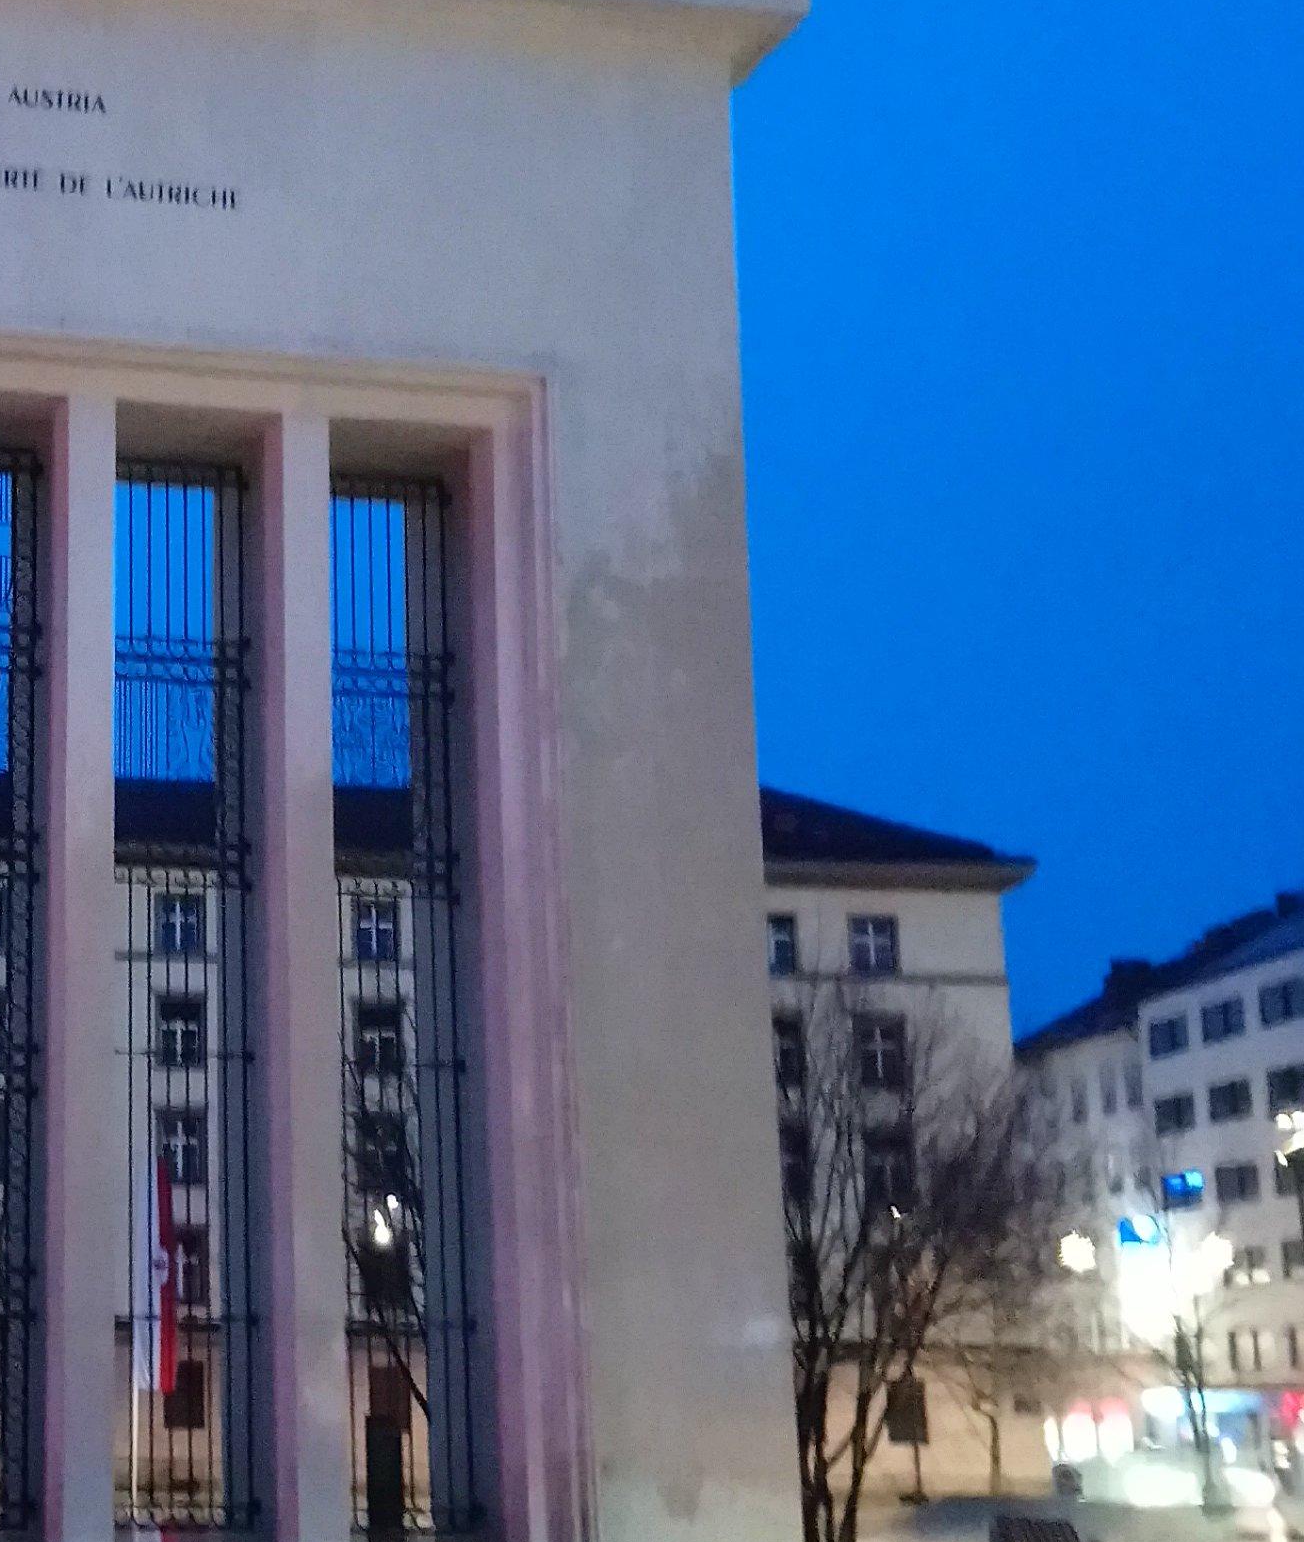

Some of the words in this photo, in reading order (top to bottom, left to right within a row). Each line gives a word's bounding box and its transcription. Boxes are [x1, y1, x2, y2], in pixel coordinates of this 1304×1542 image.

[8, 85, 107, 114] AUSTRIA
[59, 171, 89, 197] DE
[105, 176, 239, 210] L'AUTRICHE
